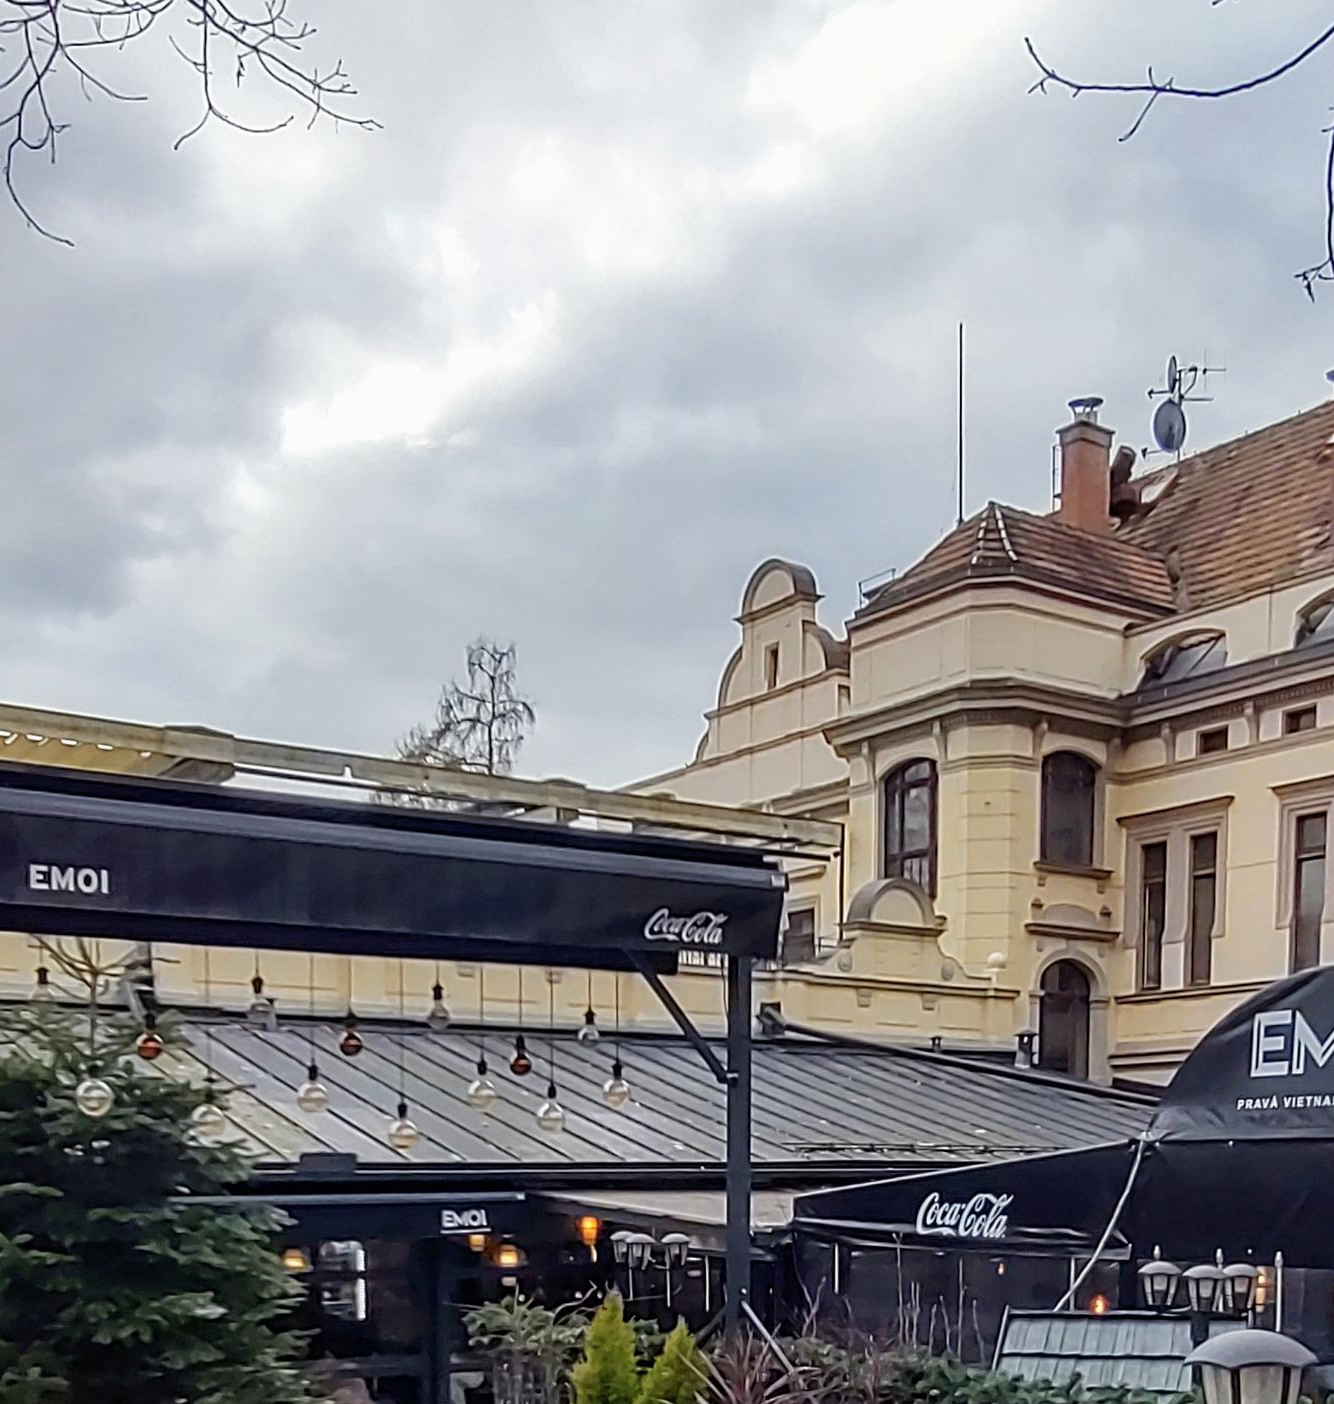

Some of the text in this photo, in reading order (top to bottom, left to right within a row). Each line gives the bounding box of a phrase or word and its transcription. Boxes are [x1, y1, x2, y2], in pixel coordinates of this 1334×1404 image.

[29, 863, 109, 894] EMOI
[644, 907, 729, 945] Coca-Cola
[441, 1209, 488, 1228] EMOI
[916, 1191, 1015, 1238] Coca-Cola
